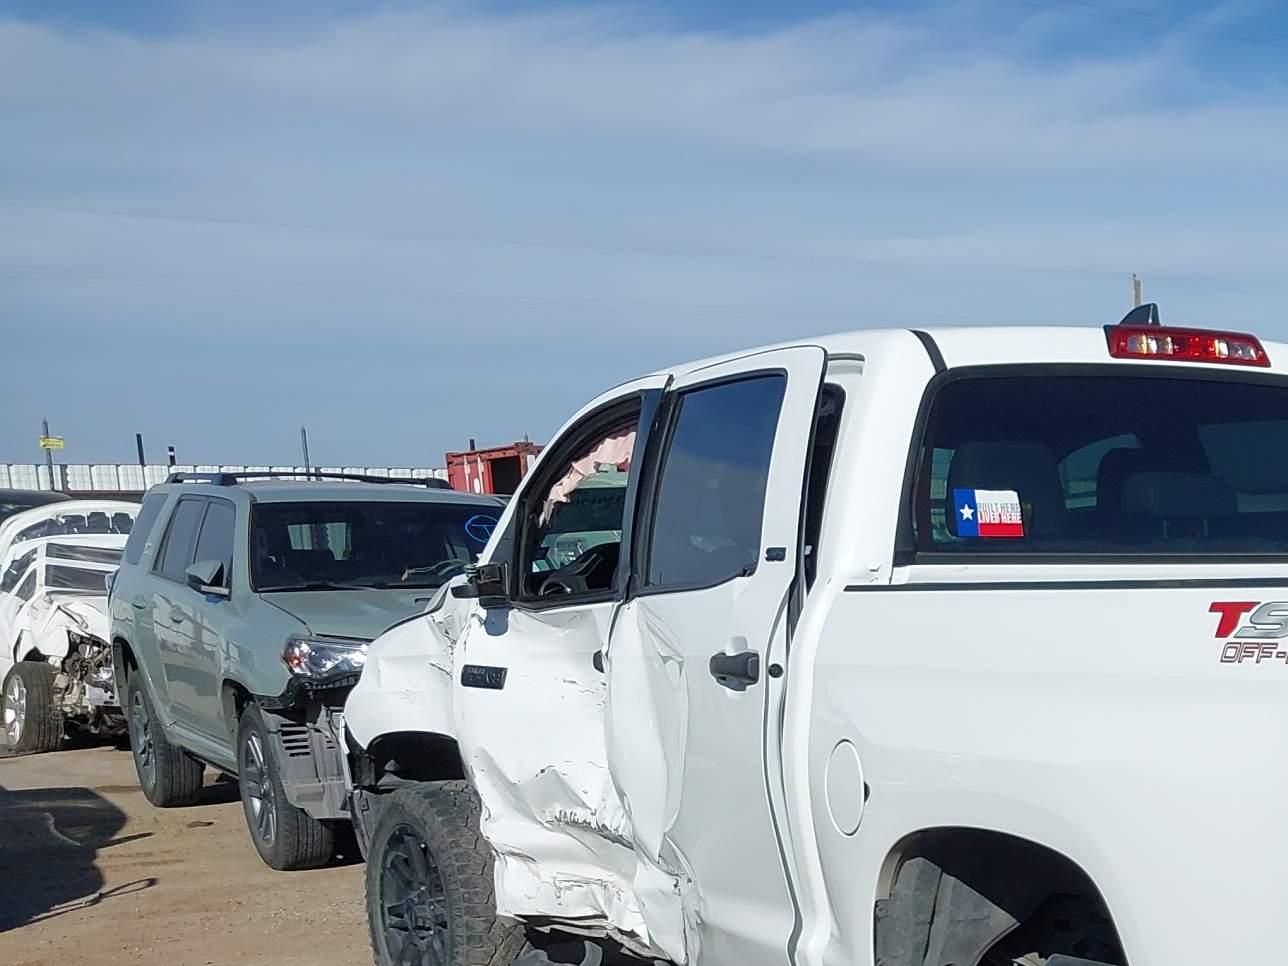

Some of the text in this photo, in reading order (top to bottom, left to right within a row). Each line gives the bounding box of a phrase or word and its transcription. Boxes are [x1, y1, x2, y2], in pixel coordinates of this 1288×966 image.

[1000, 502, 1020, 513] HERE
[978, 512, 1022, 524] LIVES HERE
